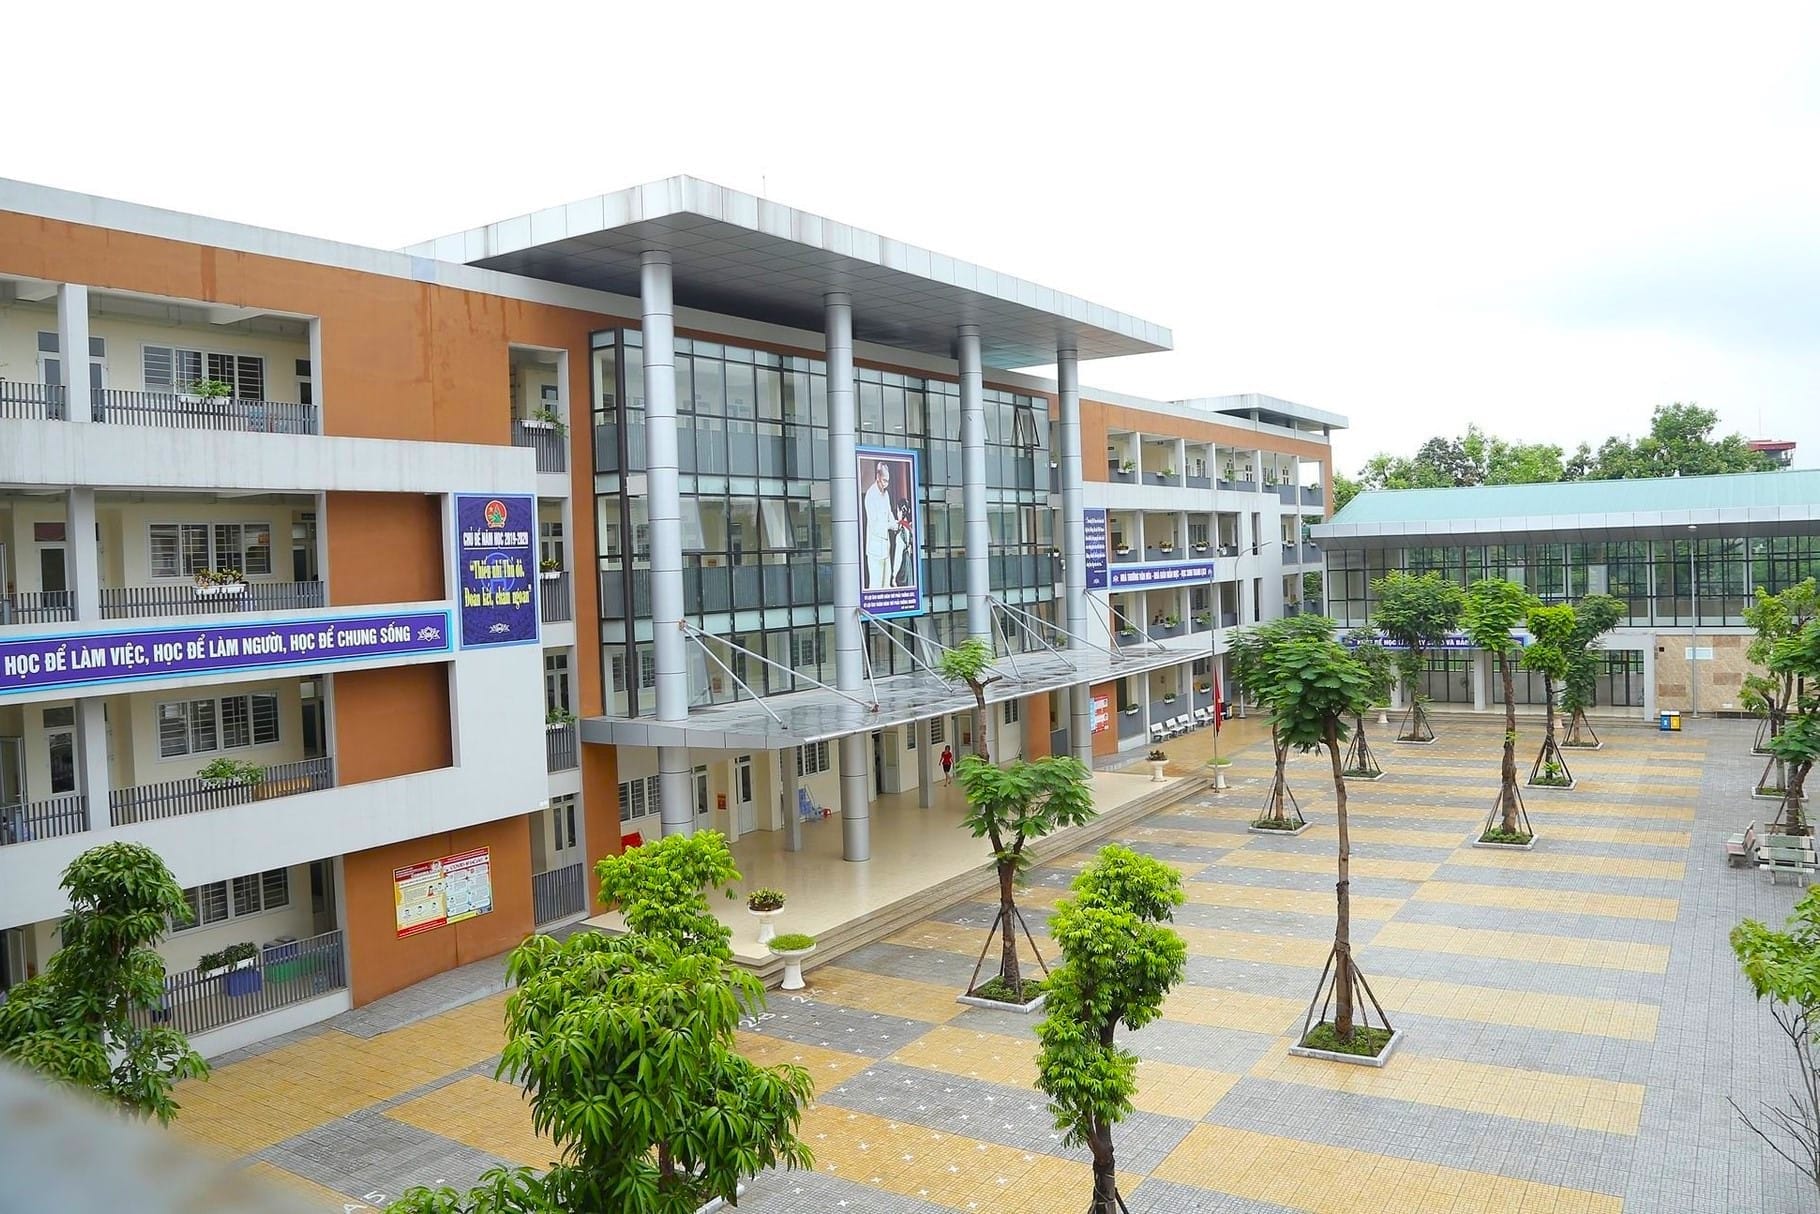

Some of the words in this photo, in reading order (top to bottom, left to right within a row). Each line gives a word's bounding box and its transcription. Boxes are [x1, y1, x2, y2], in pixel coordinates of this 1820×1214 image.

[4, 654, 39, 679] HỌC
[44, 643, 67, 672] ĐỂ
[71, 646, 106, 669] LÀM
[110, 643, 149, 668] VIỆC,
[153, 642, 183, 665] HỌC
[187, 634, 206, 660] ĐỂ
[209, 636, 238, 657] LÀM
[243, 631, 287, 655] NGƯỜI,
[290, 633, 315, 655] HỌC
[318, 625, 335, 649] ĐỂ
[337, 627, 377, 648] CHUNG
[380, 621, 411, 644] SỐNG
